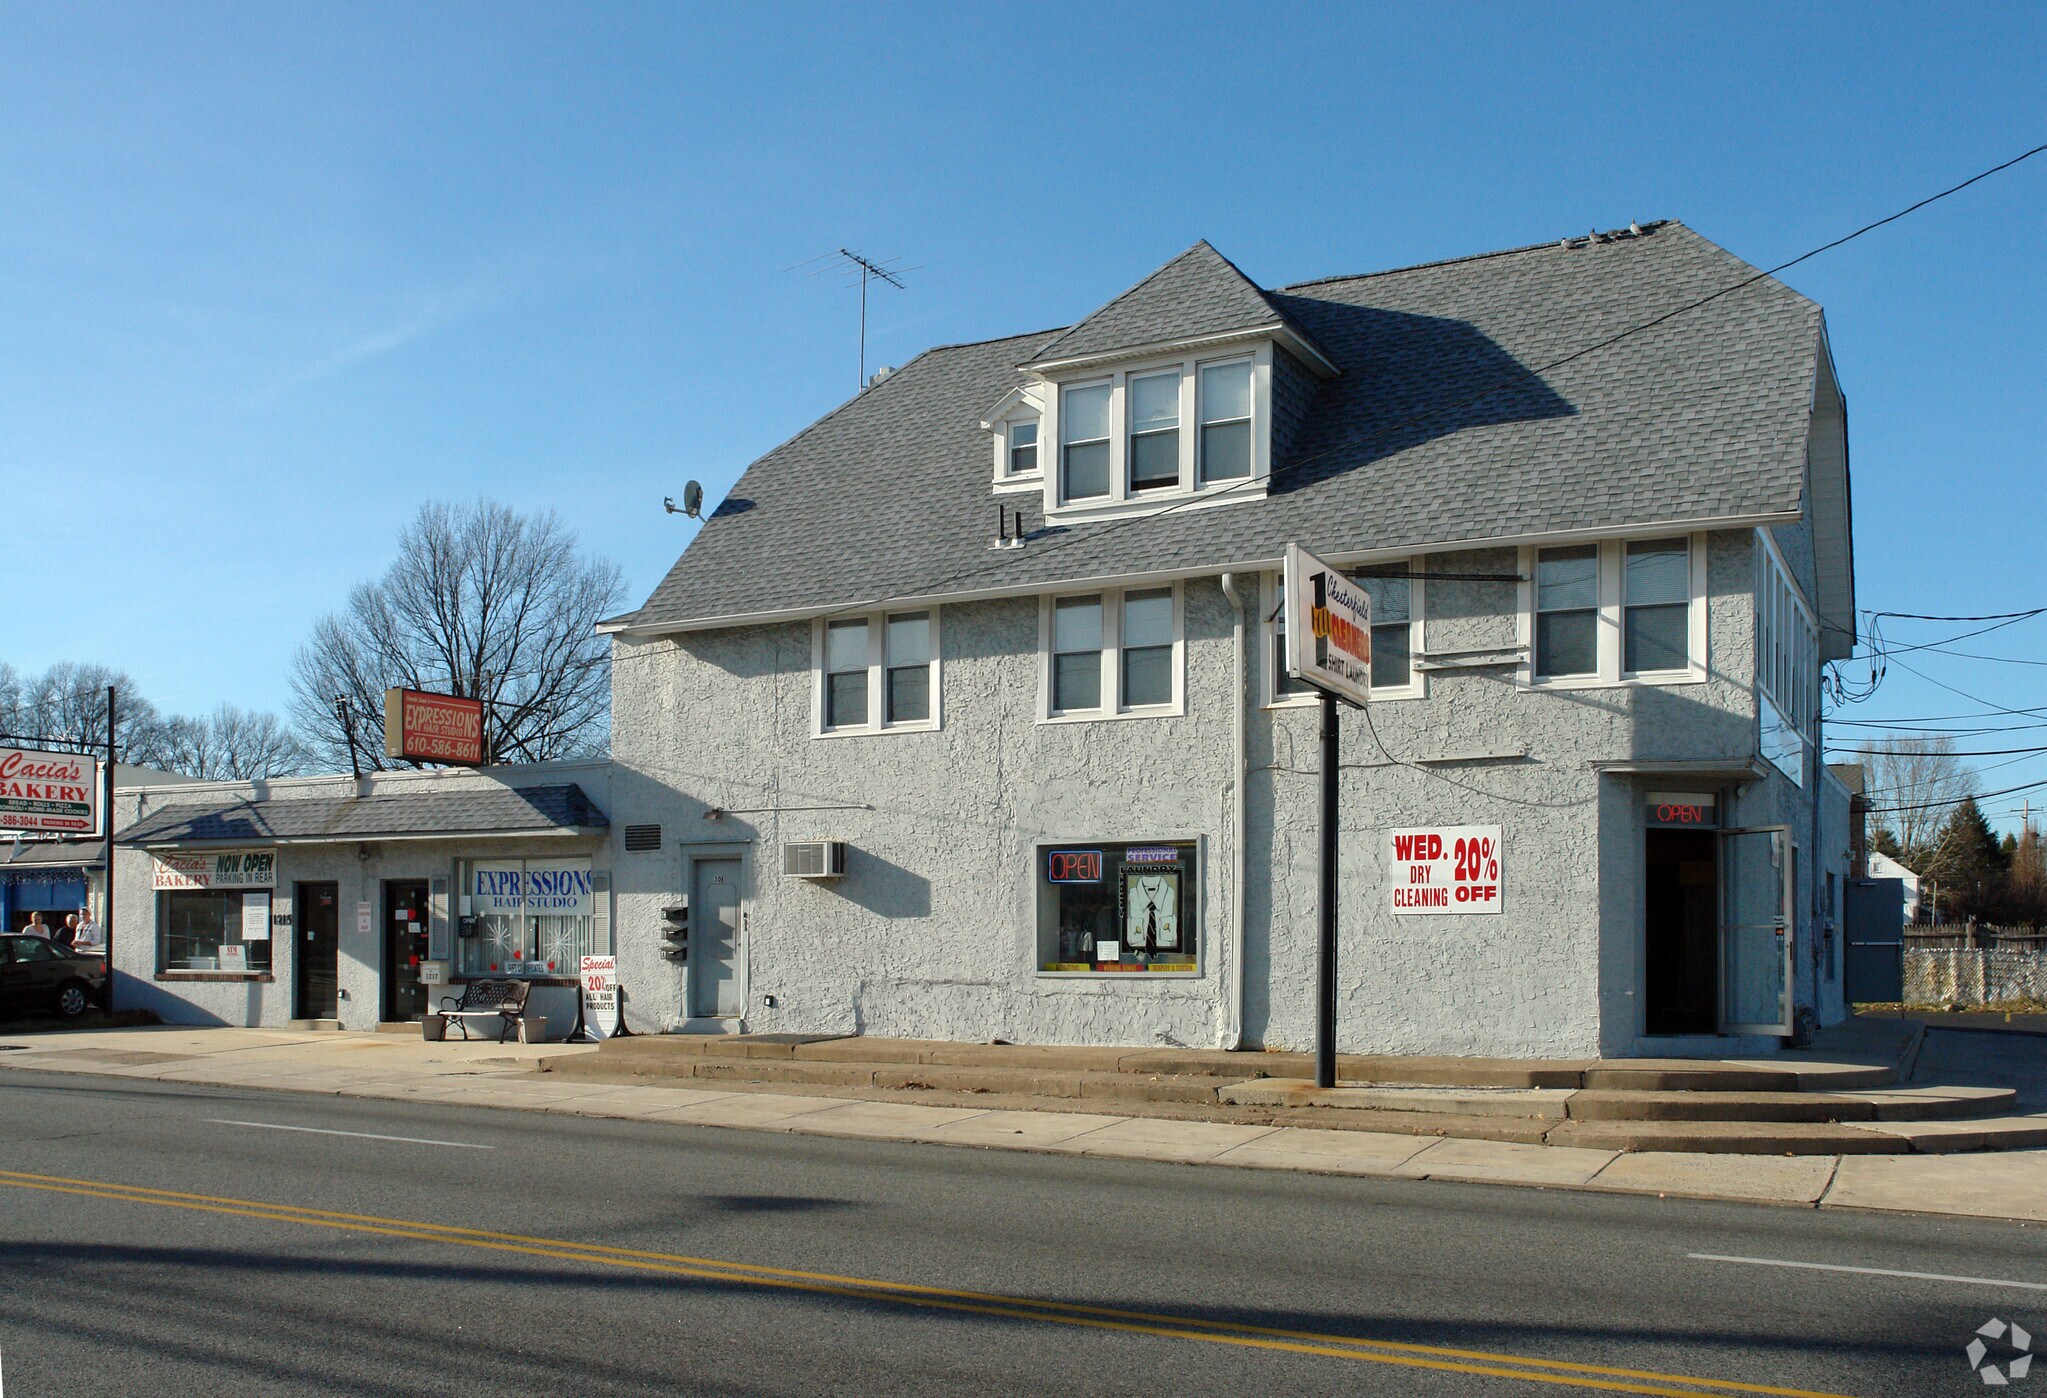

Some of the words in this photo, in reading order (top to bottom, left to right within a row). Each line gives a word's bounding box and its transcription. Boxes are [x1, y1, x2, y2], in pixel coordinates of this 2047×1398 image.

[1327, 575, 1369, 622] Chesterfield
[1331, 613, 1370, 665] CLEANERS
[1328, 653, 1344, 677] SHIRT
[406, 705, 479, 738] EXPRESSIONS
[423, 723, 440, 735] HAIR
[440, 726, 464, 737] STUDIO
[407, 736, 478, 758] 610-586-8611
[0, 752, 81, 780] Cacia's
[0, 781, 89, 801] BAKERY
[1657, 804, 1703, 823] OPEN
[159, 855, 206, 874] Cacia's
[217, 855, 241, 872] NOW
[244, 854, 273, 872] OPEN
[1051, 853, 1100, 880] OPEN
[1127, 853, 1177, 861] SERVICE
[1395, 834, 1448, 861] WED.
[1454, 837, 1498, 882] 20%
[216, 873, 244, 884] PARKING
[246, 873, 253, 883] IN
[255, 872, 273, 883] REAR
[1120, 866, 1176, 874] LAUNDRY
[1410, 865, 1432, 884] DRY
[155, 875, 211, 887] BAKERY
[527, 897, 577, 909] STUDIO
[1394, 888, 1448, 907] CLEANING
[1455, 886, 1497, 902] OFF
[273, 914, 292, 926] 1215
[582, 957, 615, 972] Special
[425, 973, 438, 981] 1217
[586, 993, 596, 1001] ALL
[600, 993, 613, 1001] HAIR
